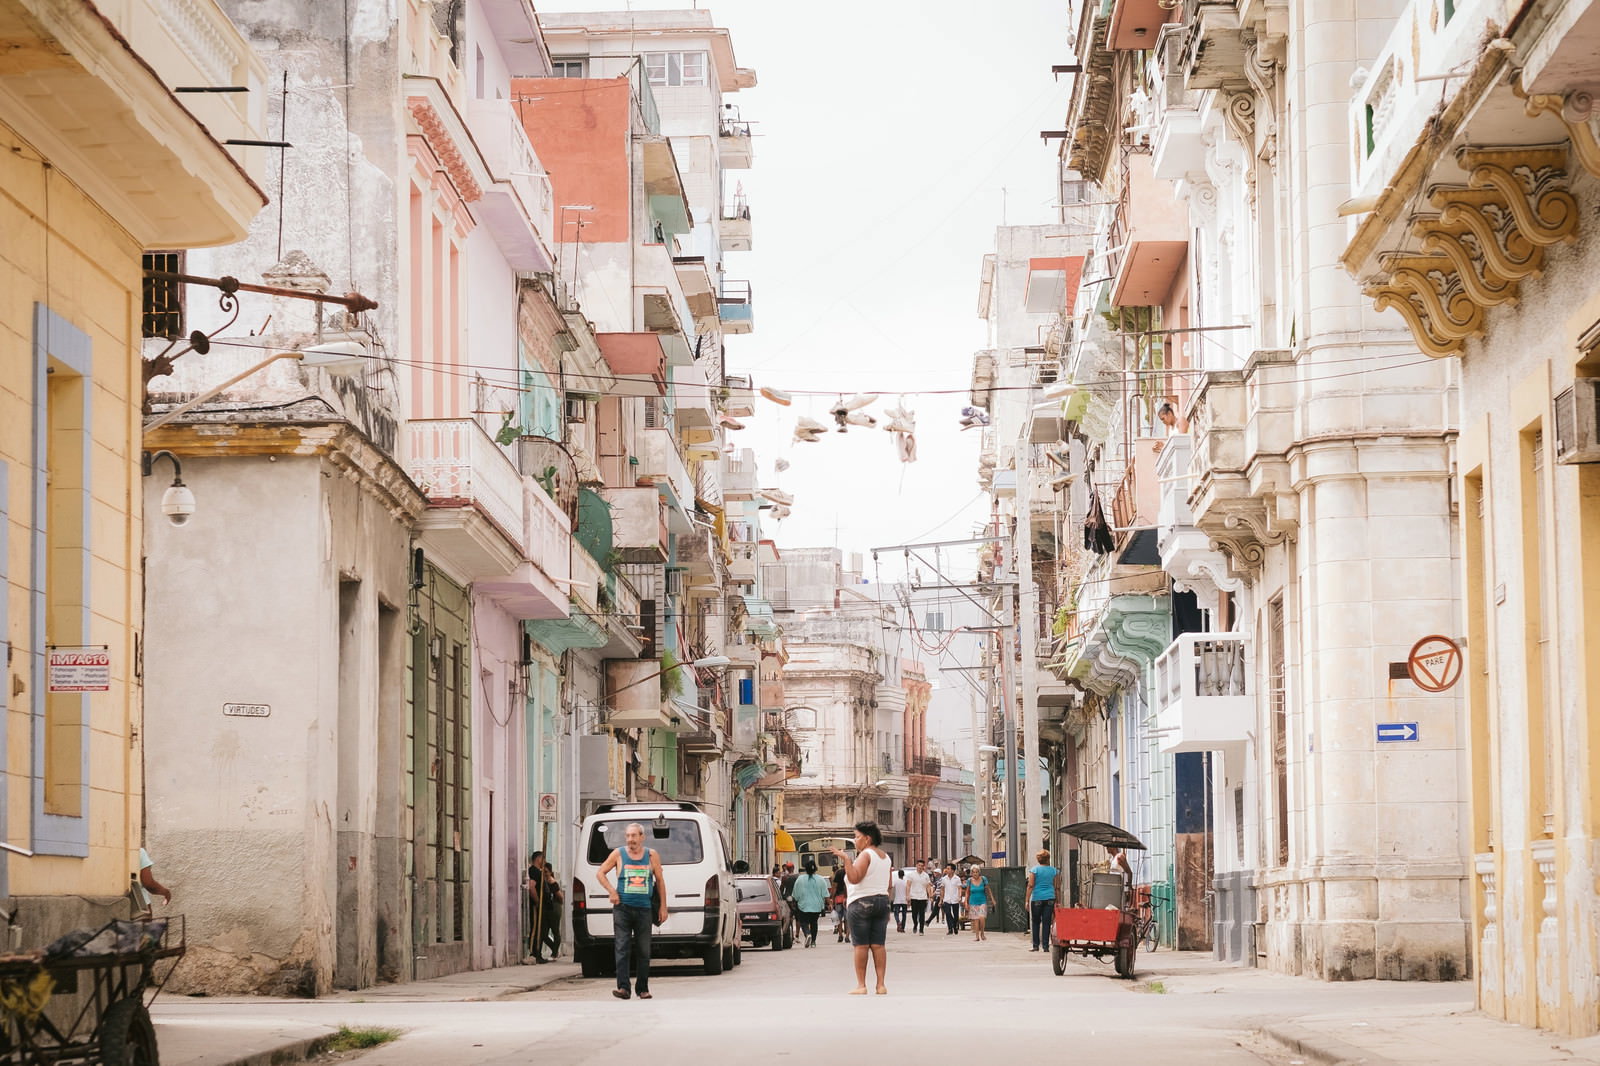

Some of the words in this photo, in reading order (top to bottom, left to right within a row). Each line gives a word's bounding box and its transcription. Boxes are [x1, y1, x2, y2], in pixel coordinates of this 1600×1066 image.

[51, 653, 108, 665] IMPACTO
[1425, 656, 1445, 667] PARE
[228, 705, 266, 715] VIRTUDES
